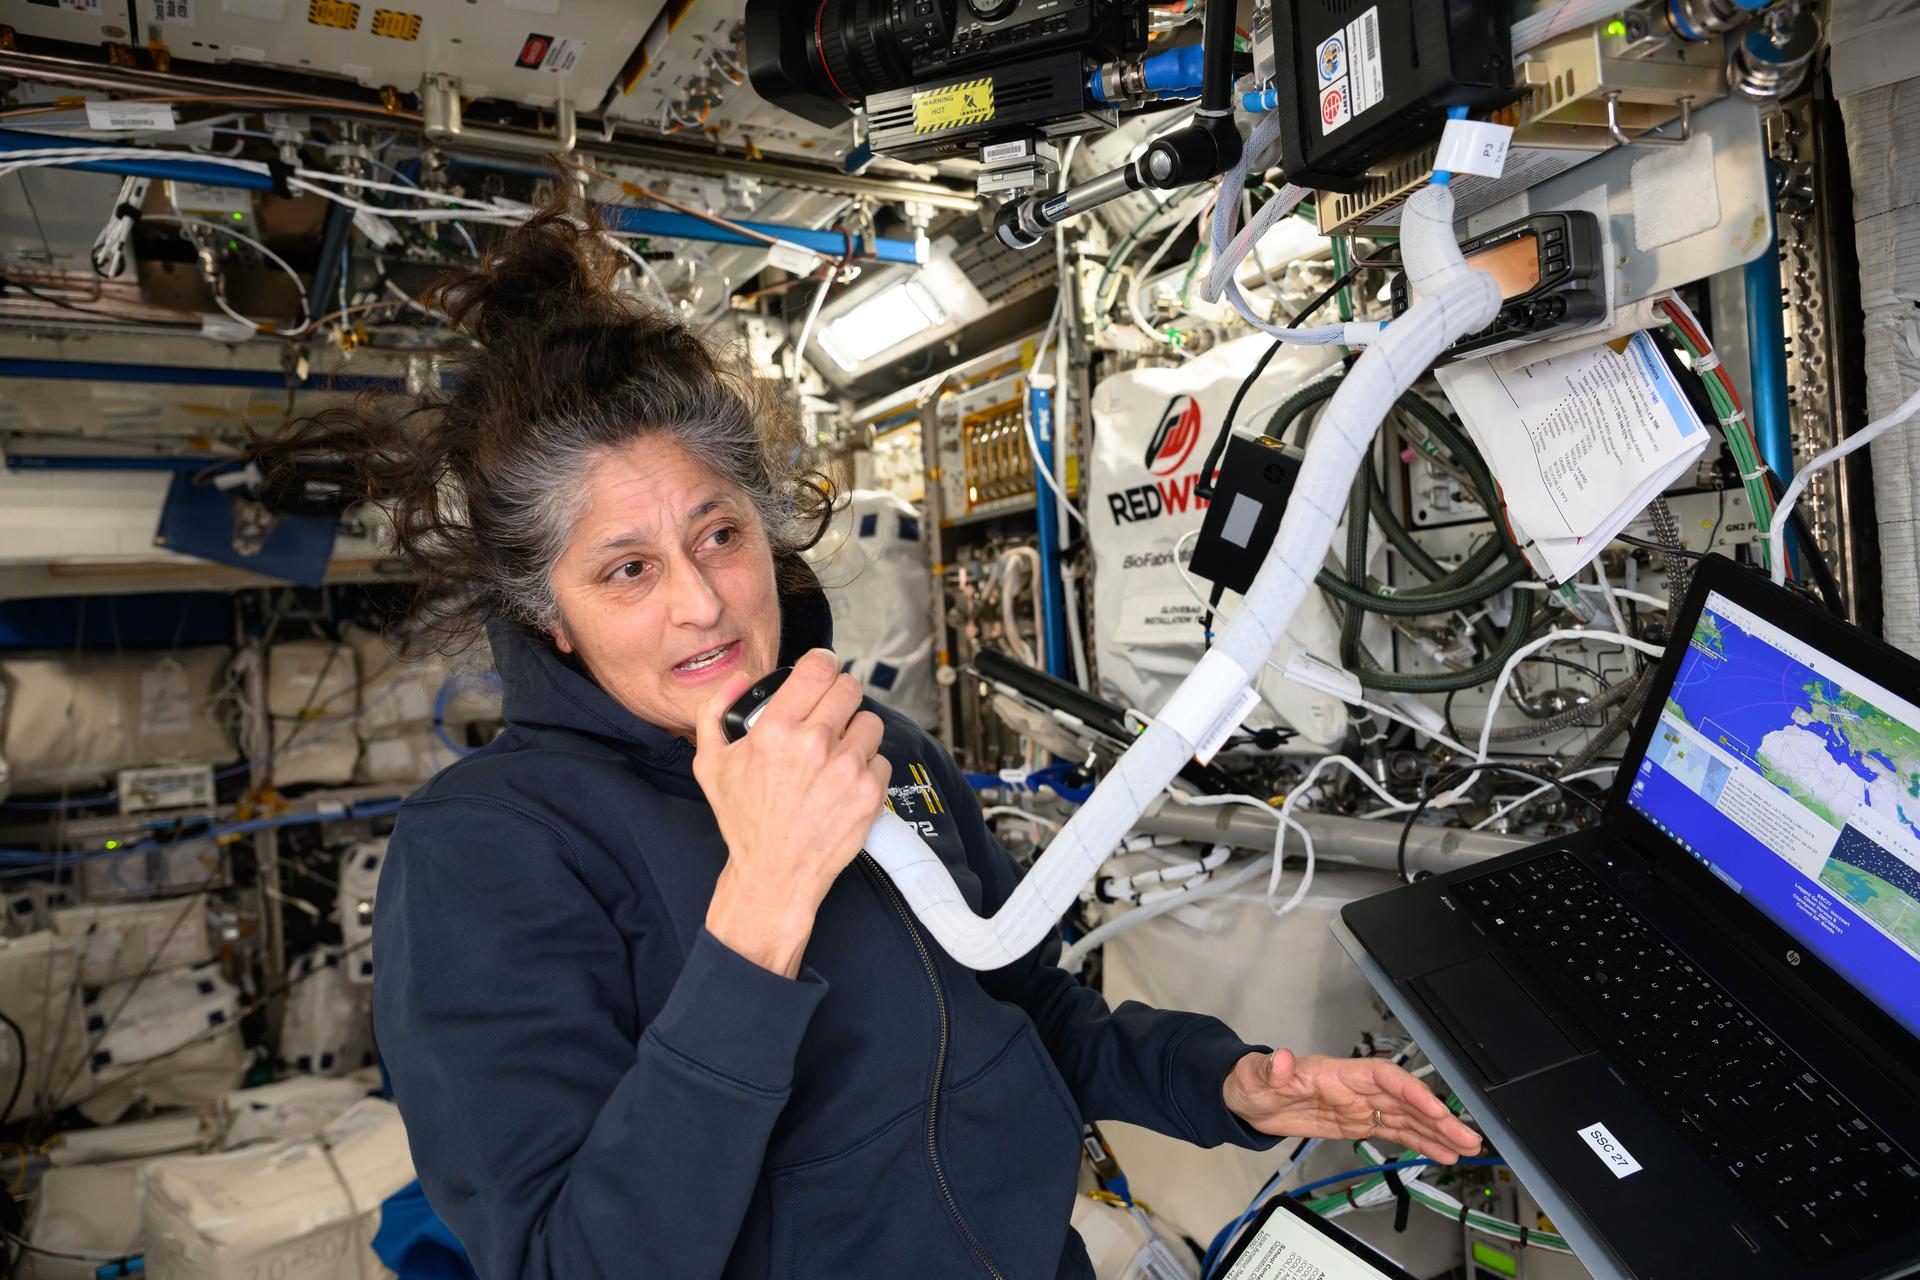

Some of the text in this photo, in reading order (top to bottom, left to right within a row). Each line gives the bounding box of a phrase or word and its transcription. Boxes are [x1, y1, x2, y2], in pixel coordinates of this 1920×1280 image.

[922, 94, 953, 106] WARNING
[1482, 142, 1493, 157] P3
[1634, 335, 1660, 380] Communications
[1726, 524, 1748, 533] GN2
[1591, 1130, 1629, 1165] SSC 27
[1256, 1232, 1270, 1248] Local
[1241, 1247, 1260, 1269] Amateur
[1254, 1239, 1281, 1273] Organization
[1268, 1243, 1286, 1264] School
[1281, 1251, 1296, 1269] (COL)
[1287, 1254, 1302, 1273] (COL)
[1293, 1259, 1308, 1277] (COL)
